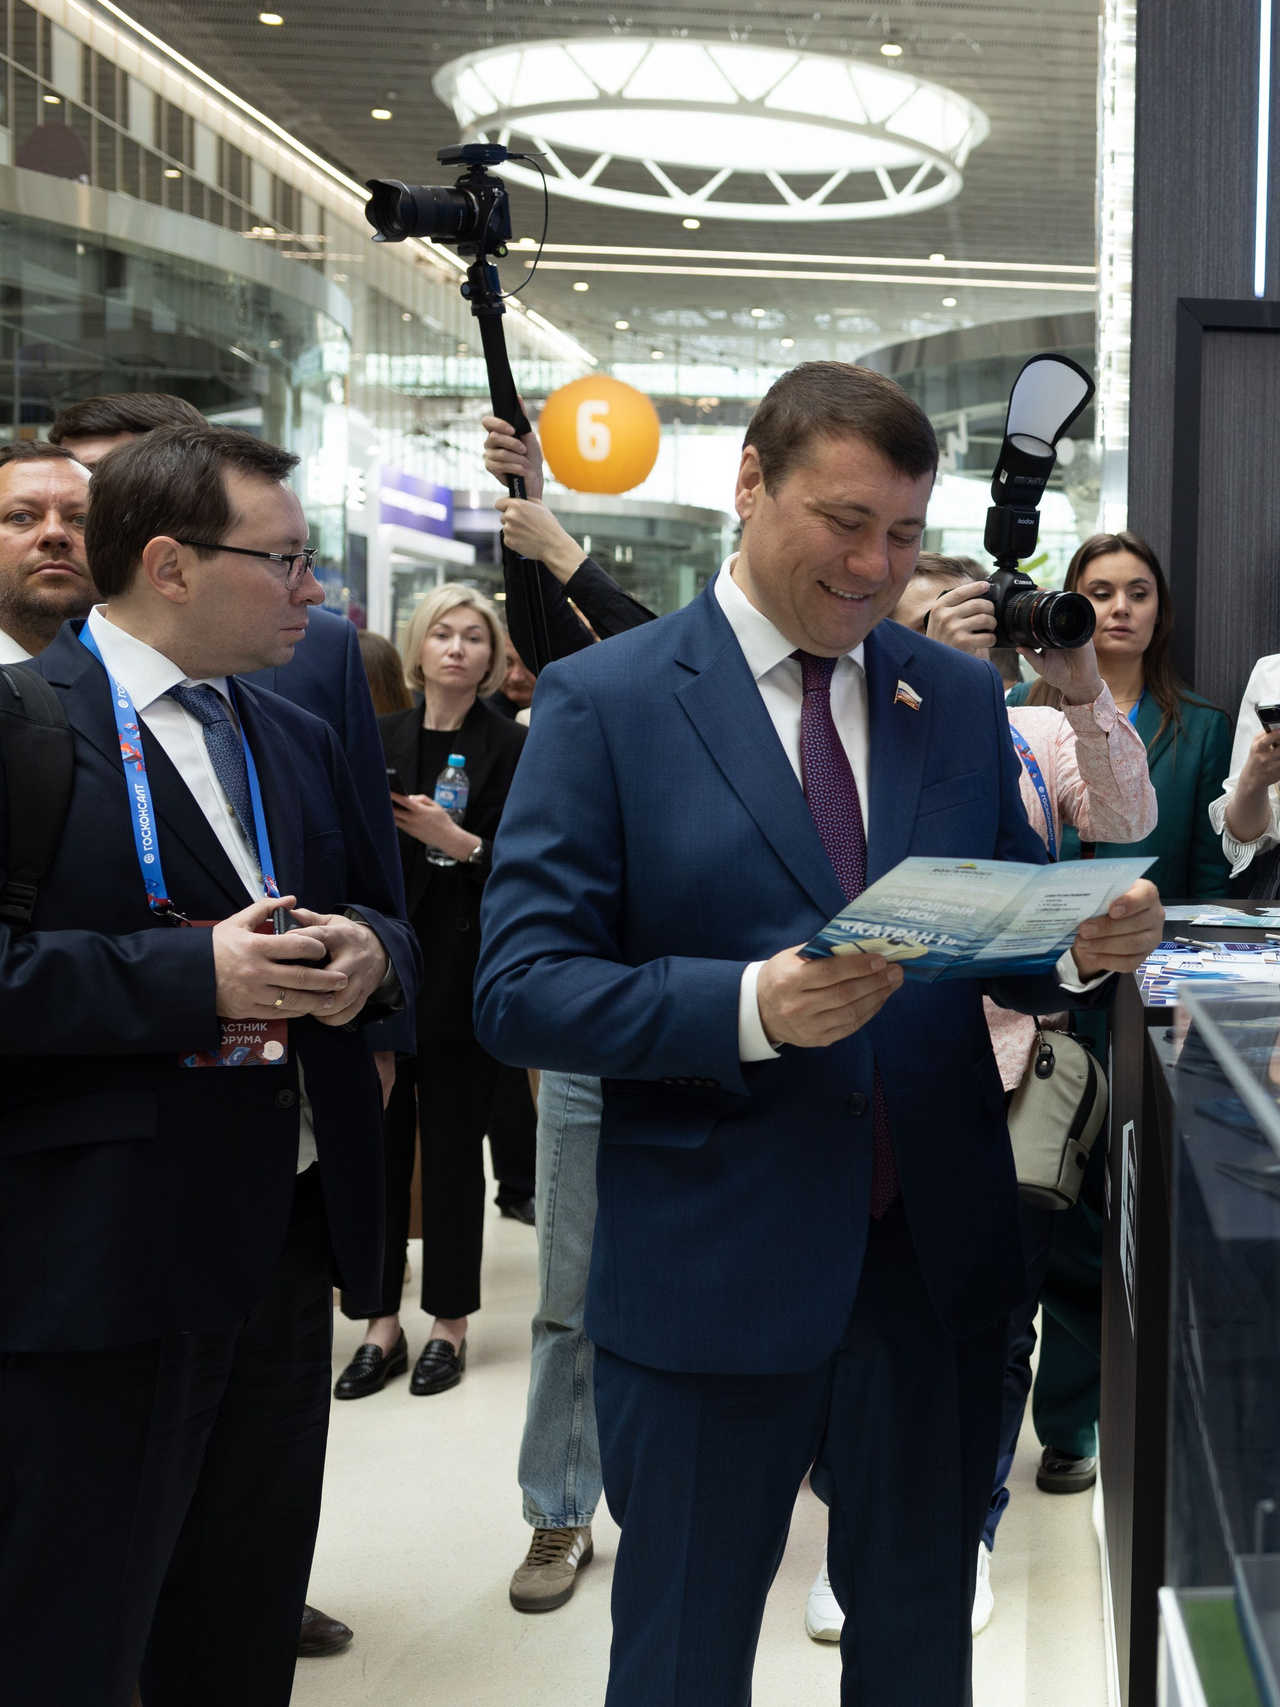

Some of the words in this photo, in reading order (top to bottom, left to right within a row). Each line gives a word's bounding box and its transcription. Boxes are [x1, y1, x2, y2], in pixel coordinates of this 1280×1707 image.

[577, 399, 611, 462] 6
[1013, 578, 1033, 586] Canon
[133, 783, 154, 851] ГОСКОНСАЛТ
[1041, 794, 1054, 841] ГОСКОНСАЛТ
[878, 895, 977, 917] НАДВОДНЫЙ
[893, 908, 940, 922] ДРОН
[220, 1022, 268, 1032] АСТНИК
[220, 1035, 262, 1045] ОРУМА
